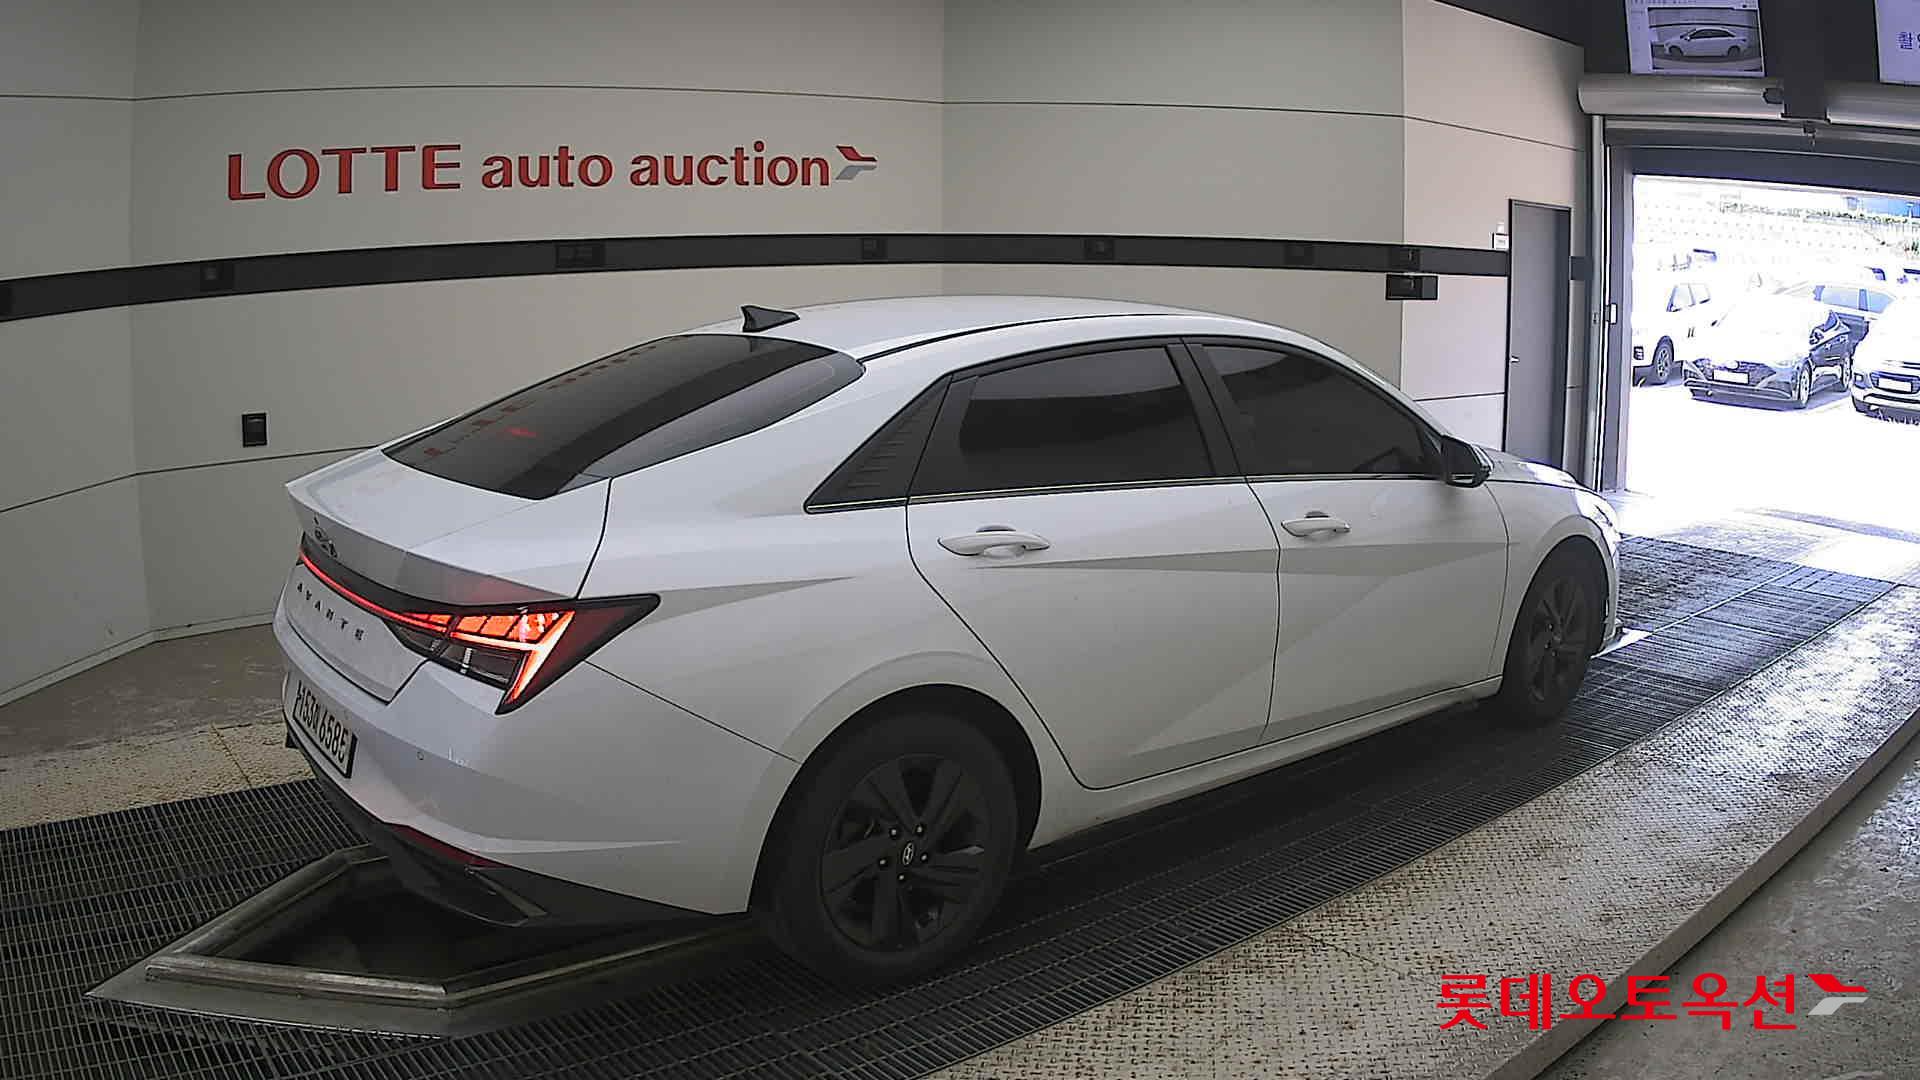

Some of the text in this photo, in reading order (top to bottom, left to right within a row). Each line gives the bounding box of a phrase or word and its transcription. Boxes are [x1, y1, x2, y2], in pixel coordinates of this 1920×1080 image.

[228, 142, 829, 201] LOTTE auto auction
[296, 582, 366, 642] AVANTE
